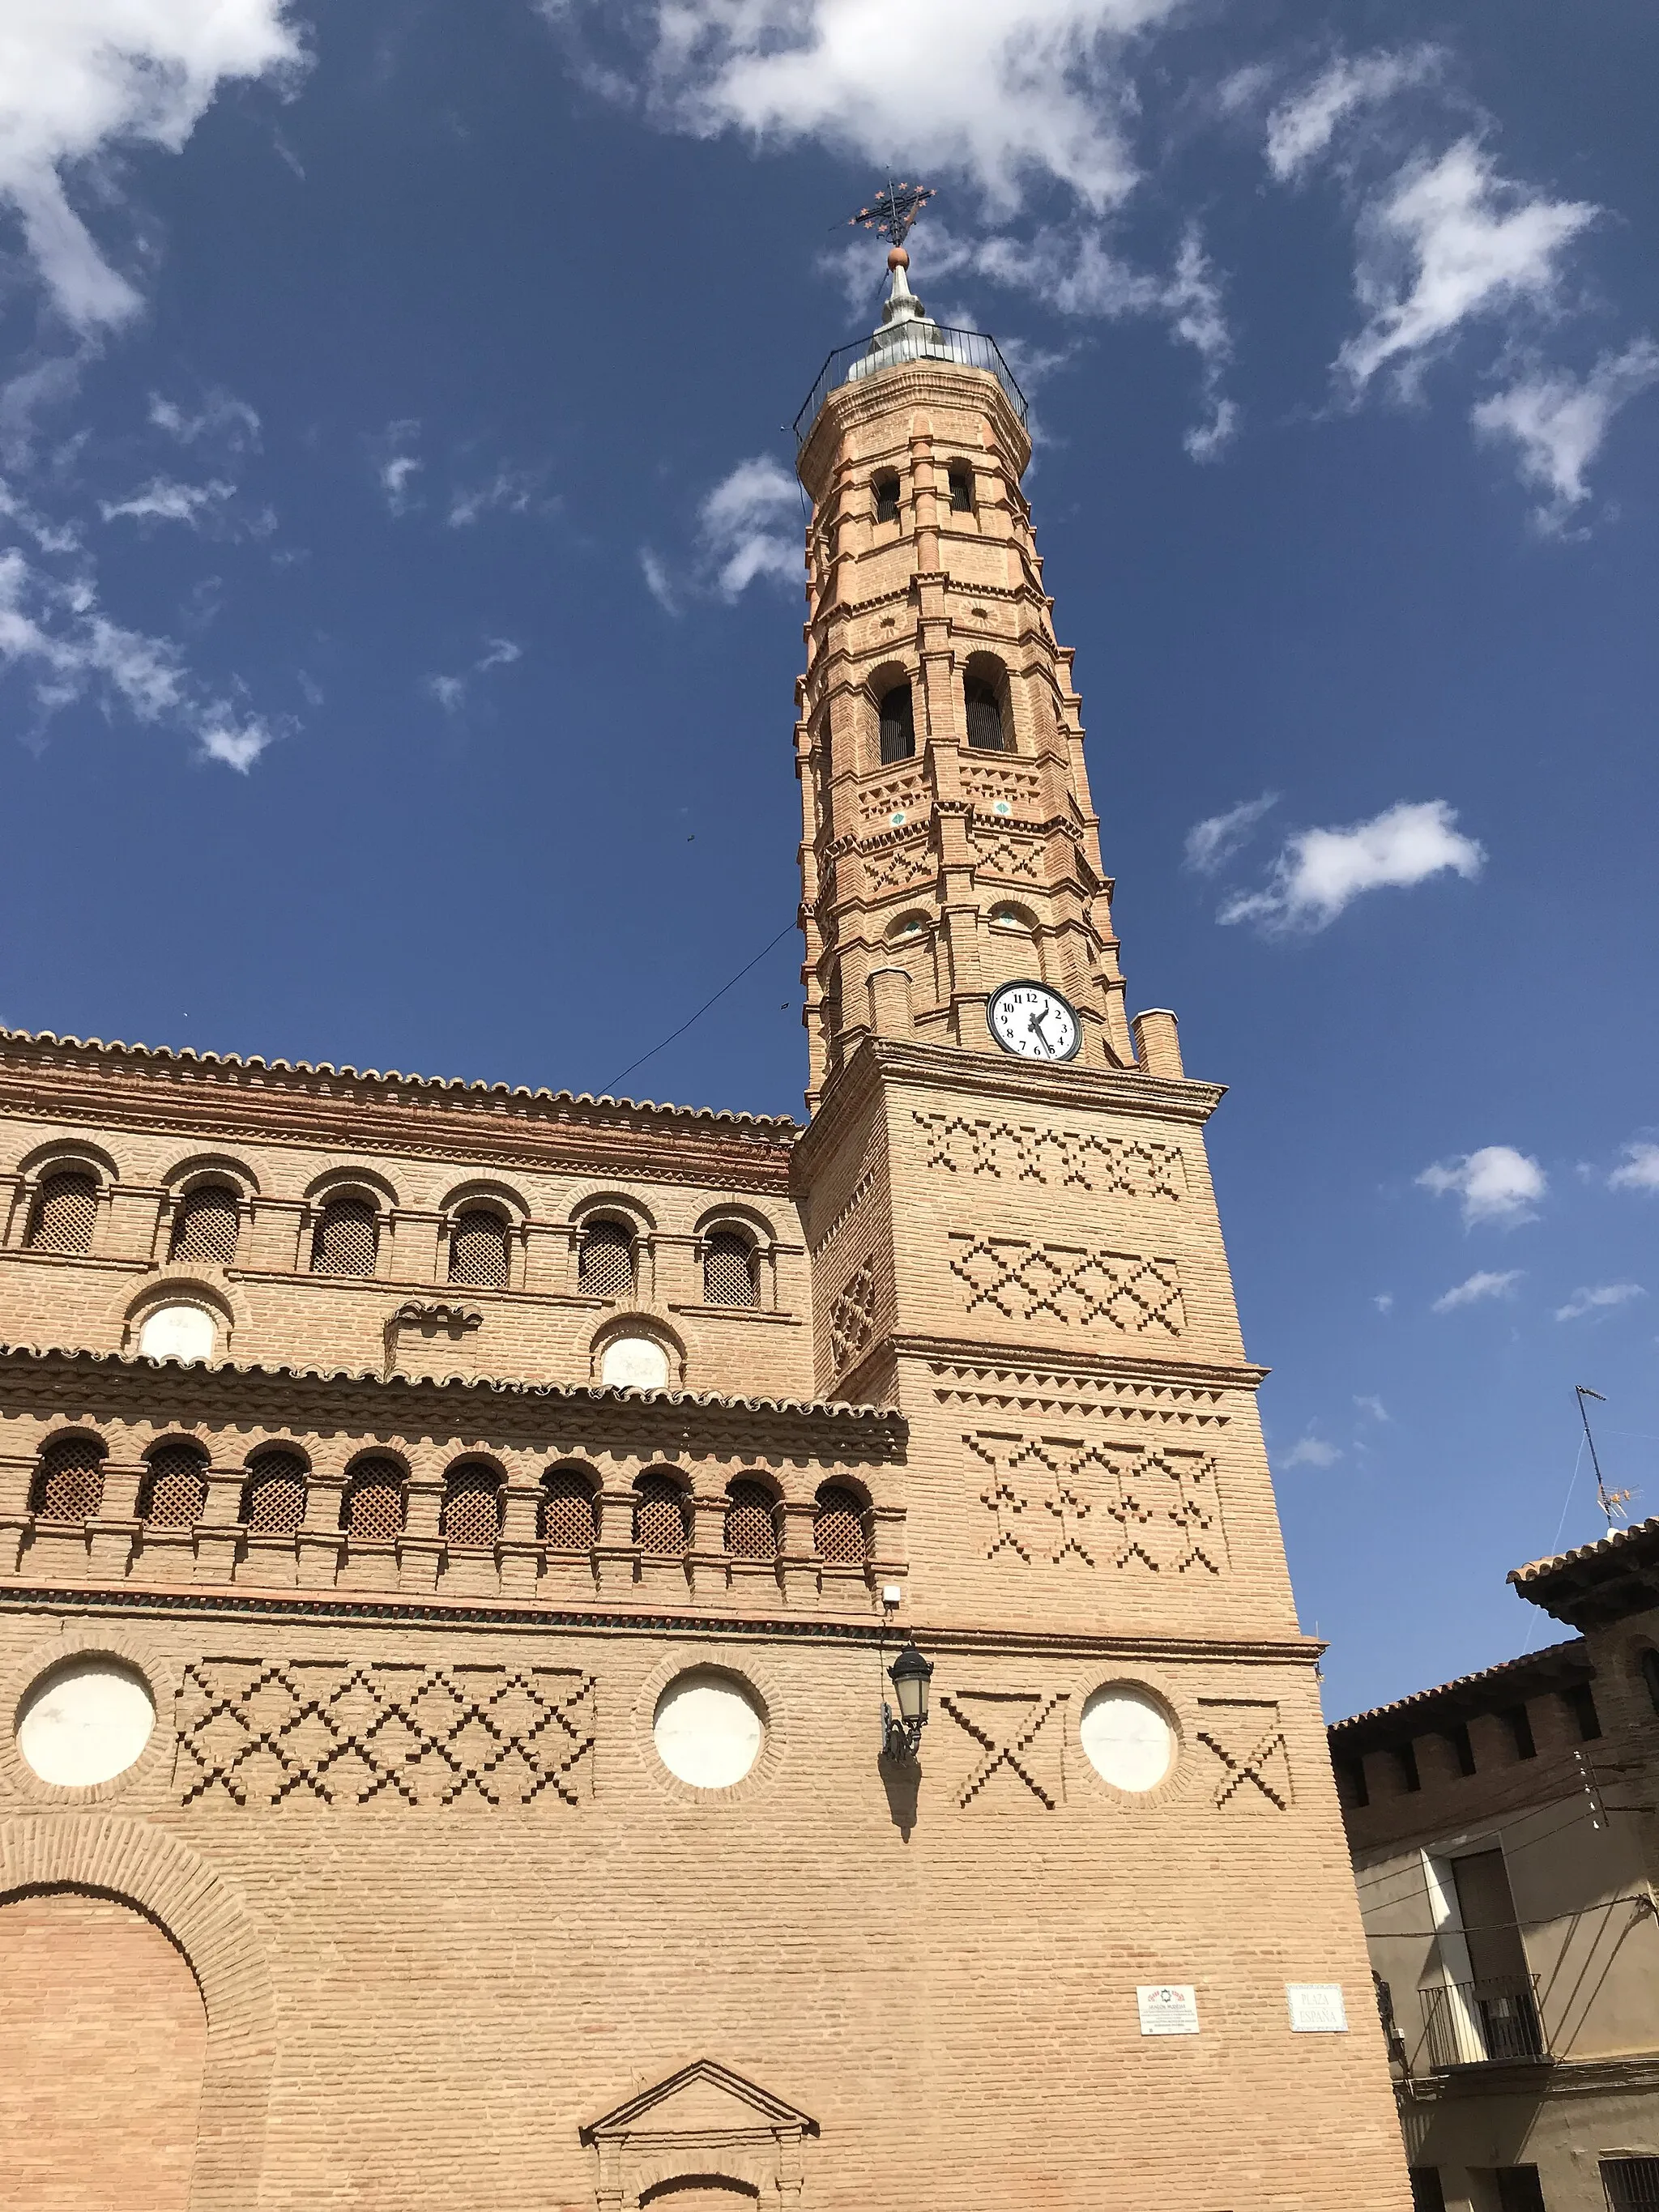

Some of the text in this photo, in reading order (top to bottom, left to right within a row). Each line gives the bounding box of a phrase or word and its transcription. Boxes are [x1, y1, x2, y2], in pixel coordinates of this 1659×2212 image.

[1013, 994, 1022, 1004] 11
[1026, 993, 1038, 1003] 12
[1003, 1003, 1014, 1012] 10
[1044, 999, 1048, 1008] 1
[1055, 1010, 1061, 1020] 2
[1001, 1015, 1008, 1025] 9
[1061, 1024, 1067, 1033] 3
[1006, 1029, 1013, 1038] 8
[1057, 1036, 1064, 1045] 4
[1019, 1041, 1026, 1050] 7
[1034, 1046, 1041, 1055] 6
[1301, 1993, 1329, 2005] PLAZA
[1299, 2007, 1337, 2022] ESPAÑA
